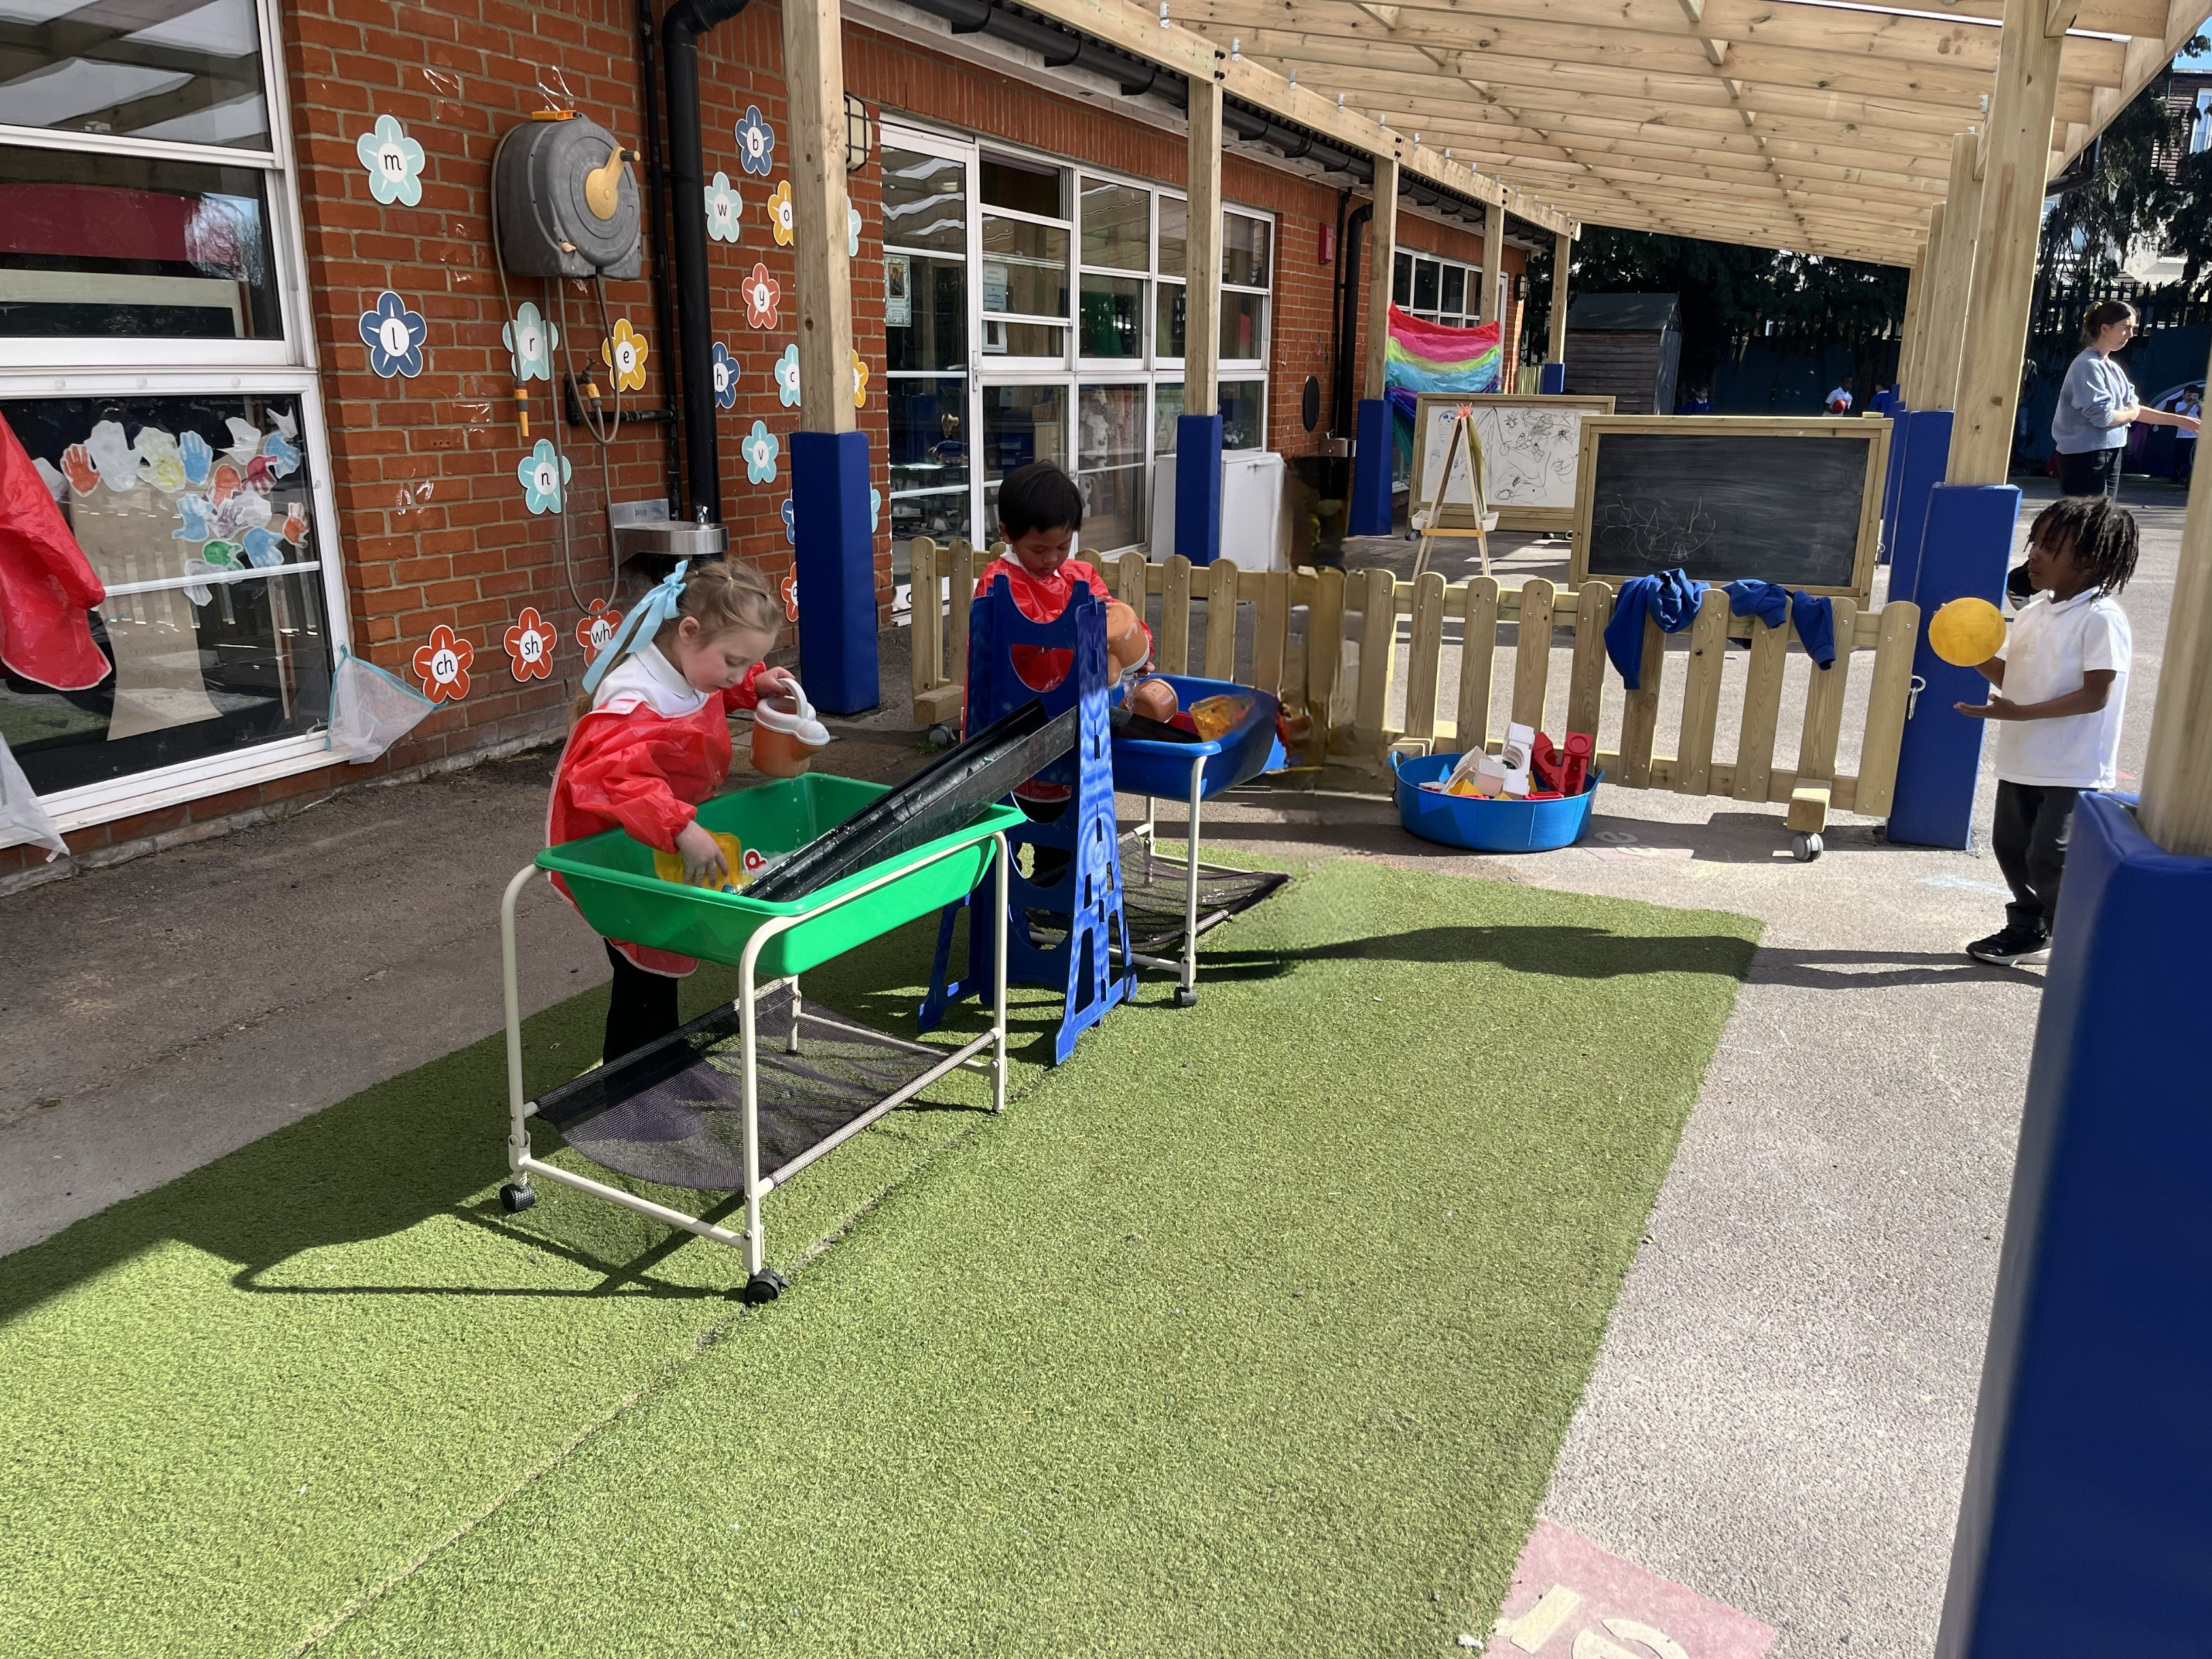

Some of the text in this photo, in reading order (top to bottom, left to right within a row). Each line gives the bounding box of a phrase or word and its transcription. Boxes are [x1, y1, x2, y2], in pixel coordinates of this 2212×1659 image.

[752, 132, 759, 150] b
[384, 154, 402, 171] m
[717, 204, 728, 216] w
[759, 291, 765, 306] y
[392, 327, 398, 350] l
[529, 337, 535, 352] r
[624, 350, 630, 364] e
[716, 368, 724, 386] h
[790, 371, 795, 382] c
[758, 449, 763, 460] v
[541, 472, 550, 486] n
[592, 624, 612, 643] wh
[525, 635, 540, 655] sh
[436, 654, 455, 675] ch
